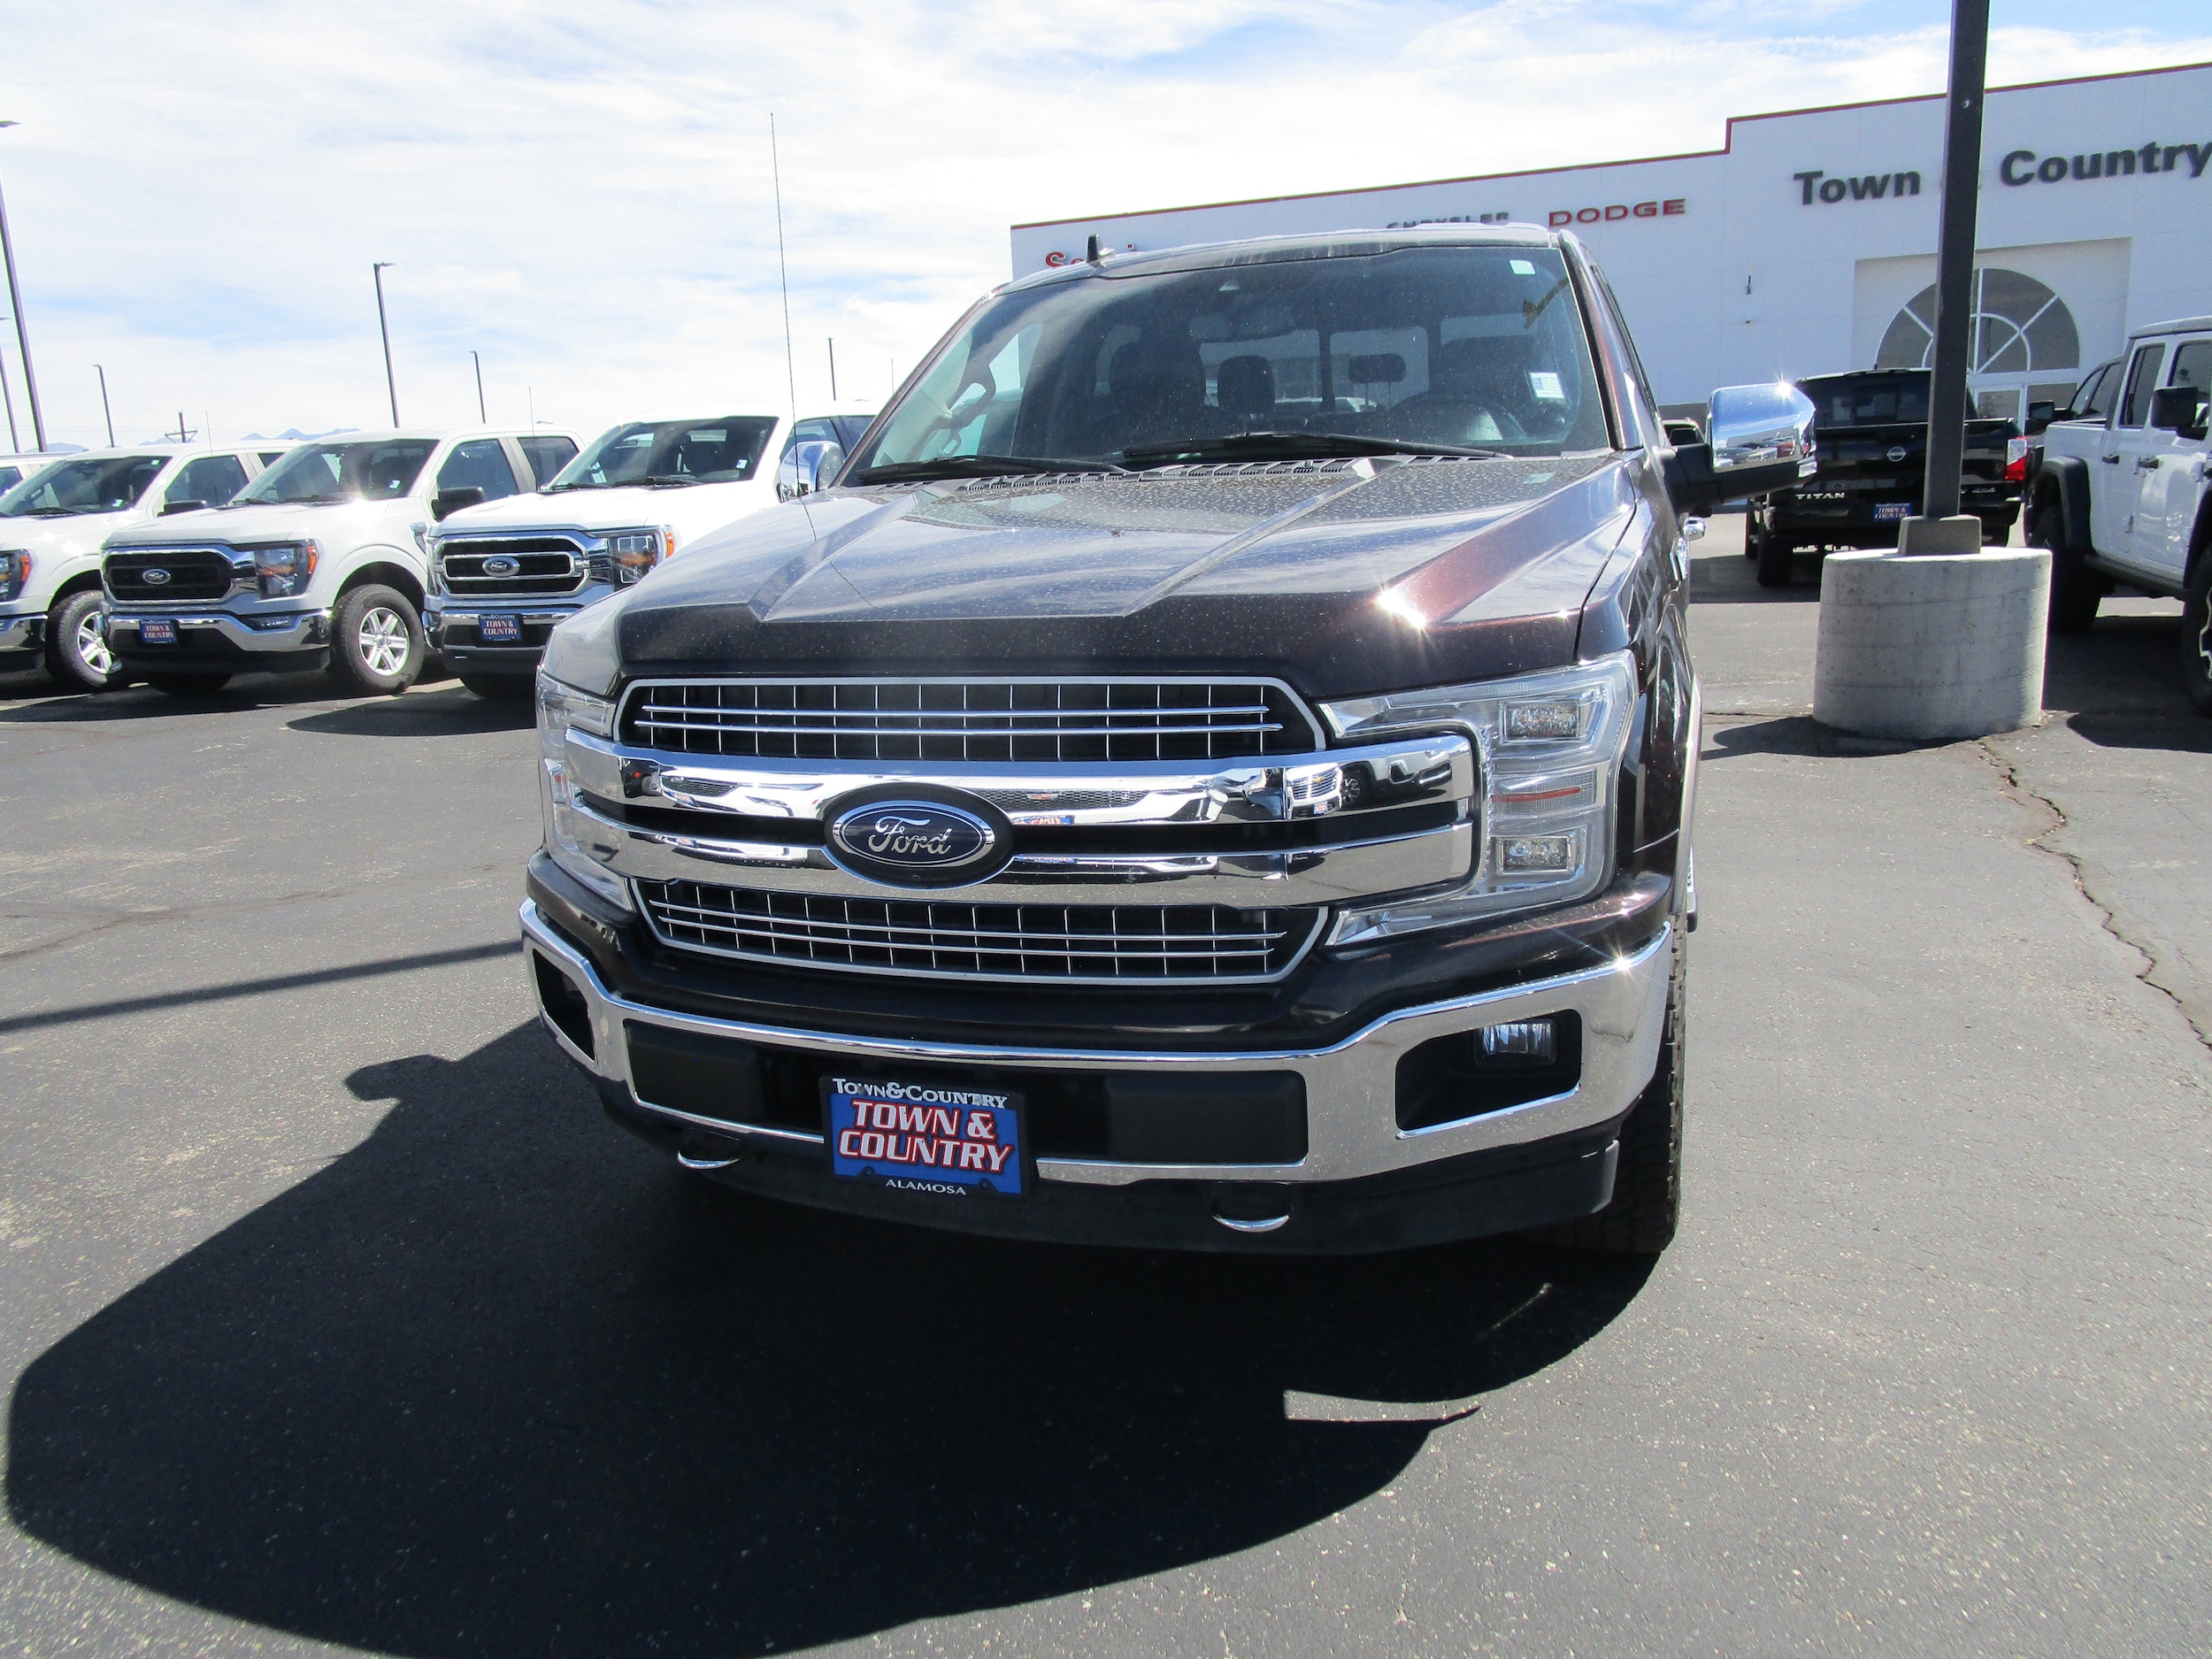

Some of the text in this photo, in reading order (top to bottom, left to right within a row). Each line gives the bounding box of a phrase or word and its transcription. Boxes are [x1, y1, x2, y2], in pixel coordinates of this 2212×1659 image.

[1793, 141, 2212, 207] Town Country
[1549, 198, 1686, 227] DODGE
[868, 816, 953, 855] Ford
[851, 1100, 996, 1141] TOWN &
[838, 1129, 1014, 1174] COUNTRY
[886, 1179, 967, 1195] ALAMOSA
